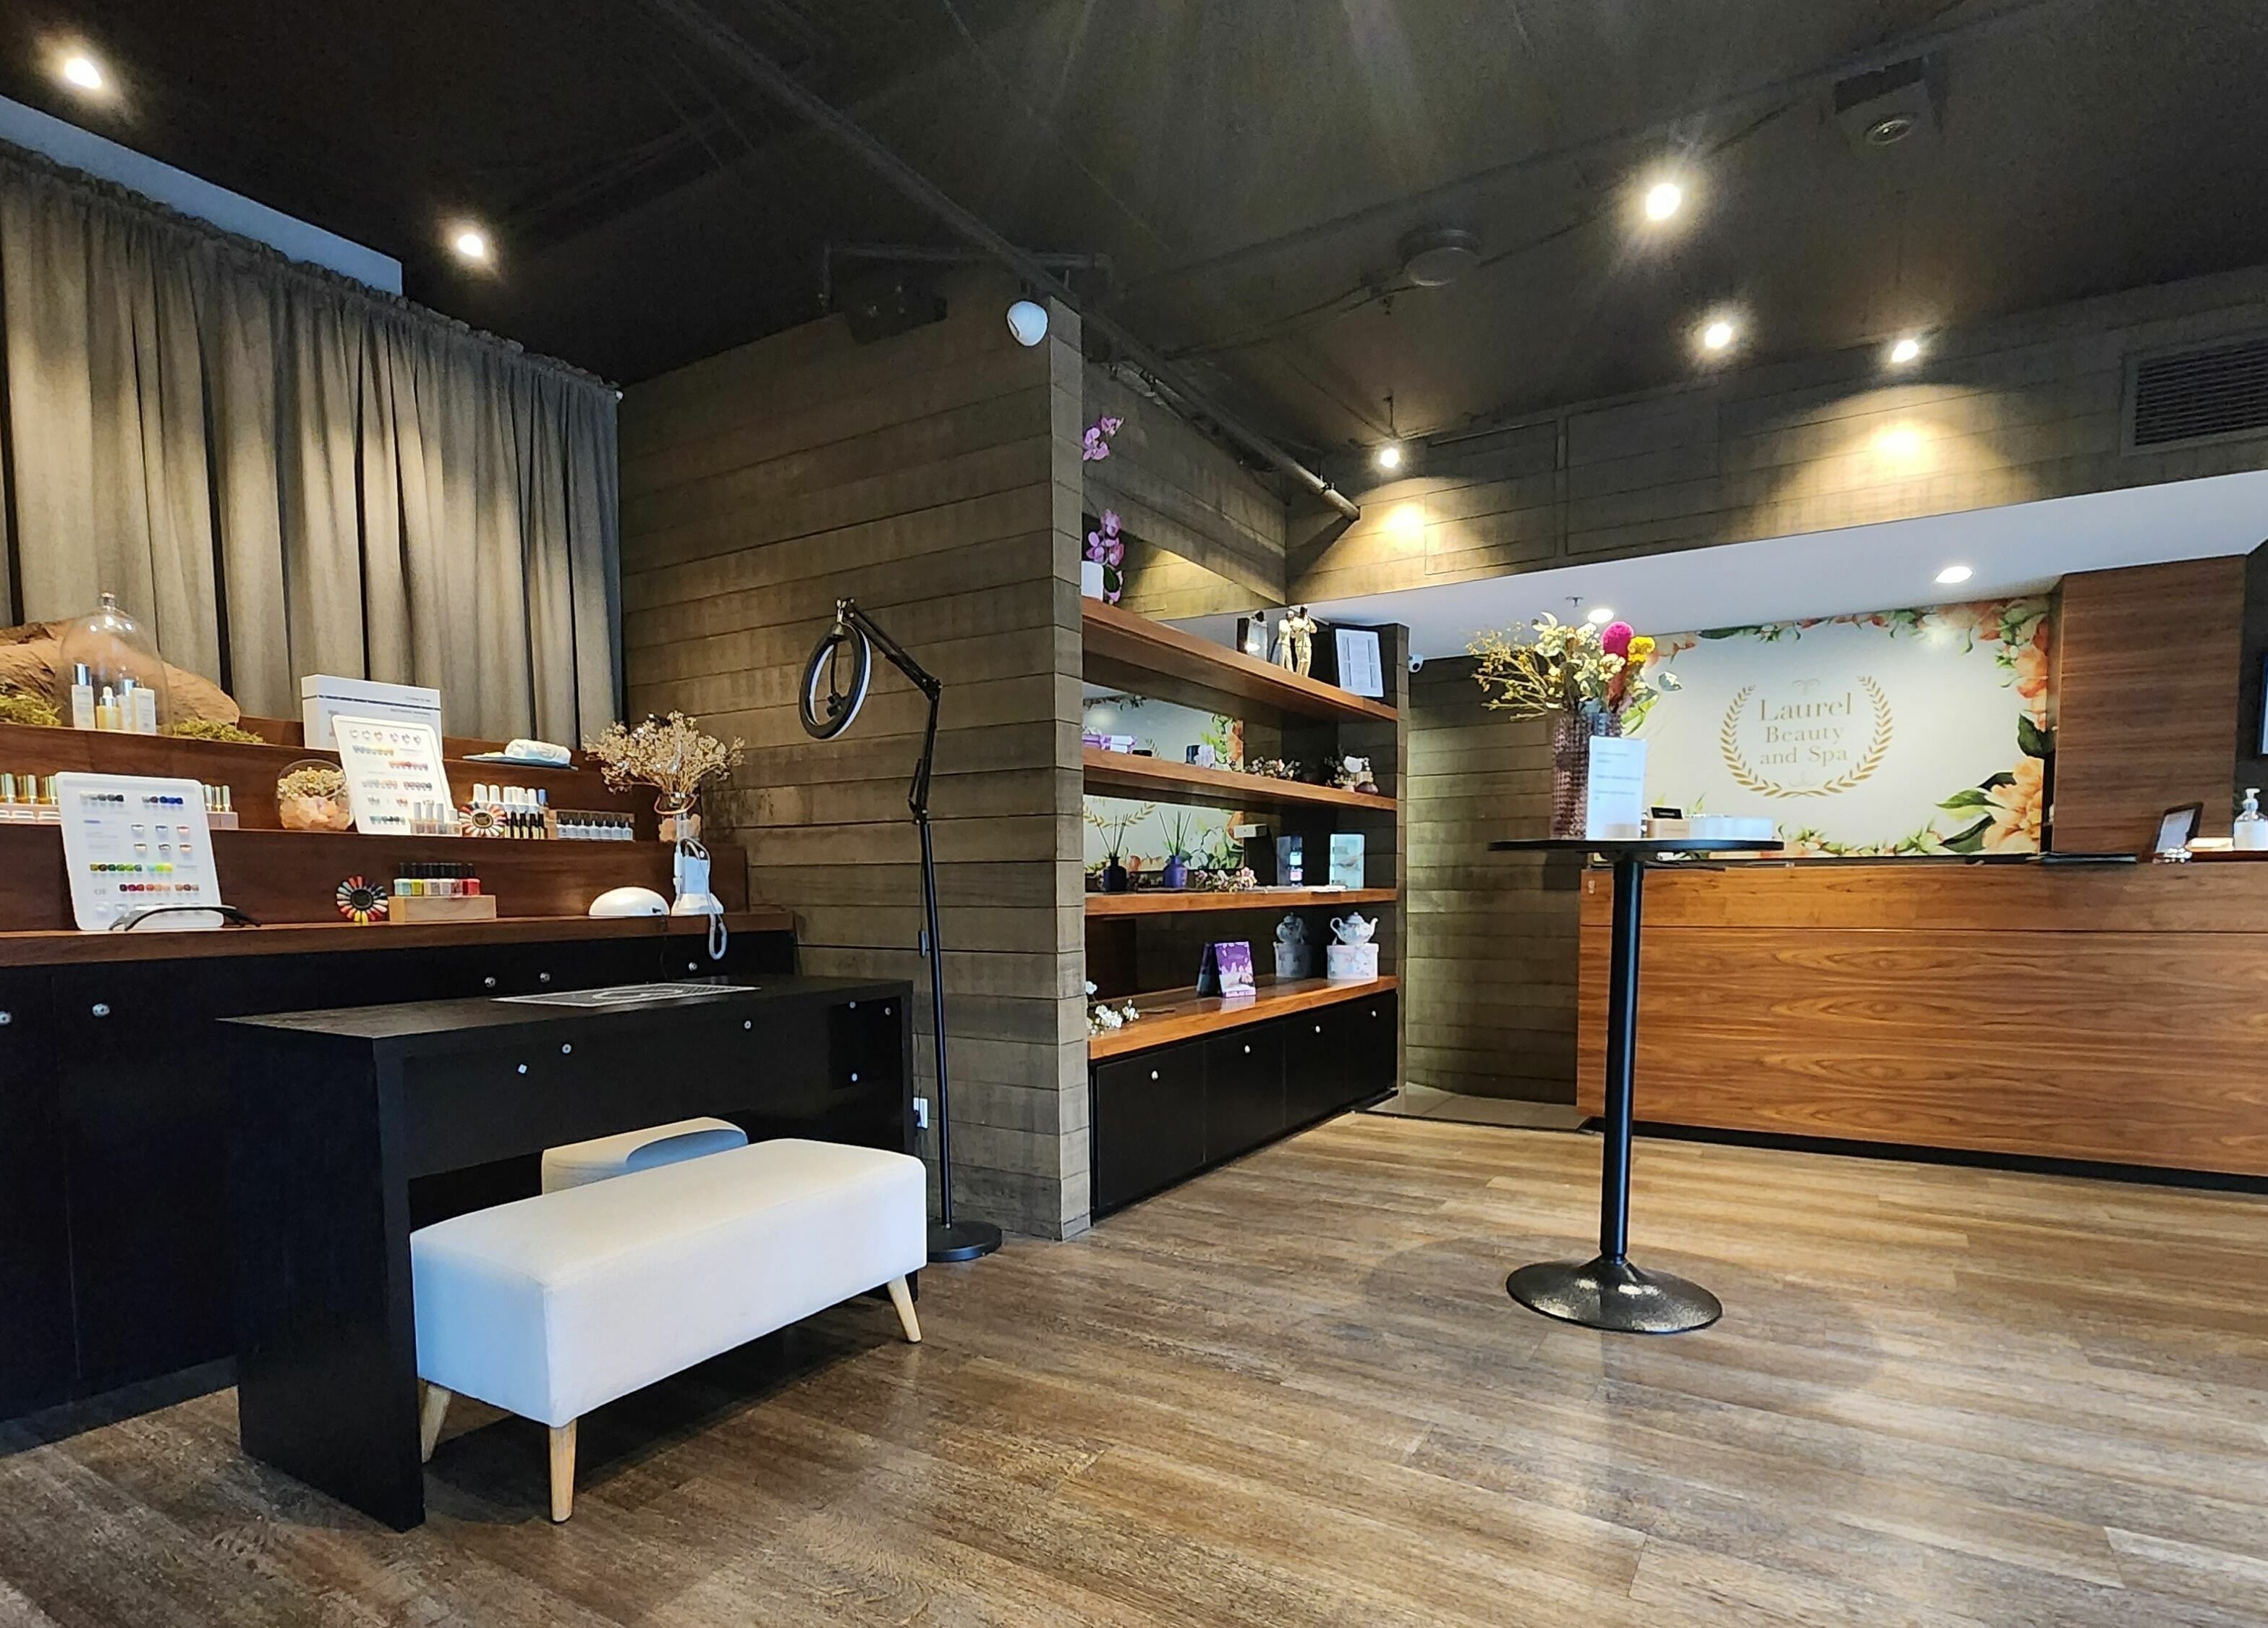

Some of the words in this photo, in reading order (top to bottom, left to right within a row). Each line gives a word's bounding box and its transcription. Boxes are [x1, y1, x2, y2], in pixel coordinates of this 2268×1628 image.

[1760, 692, 1851, 721] Laurel
[1766, 726, 1844, 745] Beauty
[1759, 747, 1797, 765] and
[1808, 745, 1848, 767] Spa
